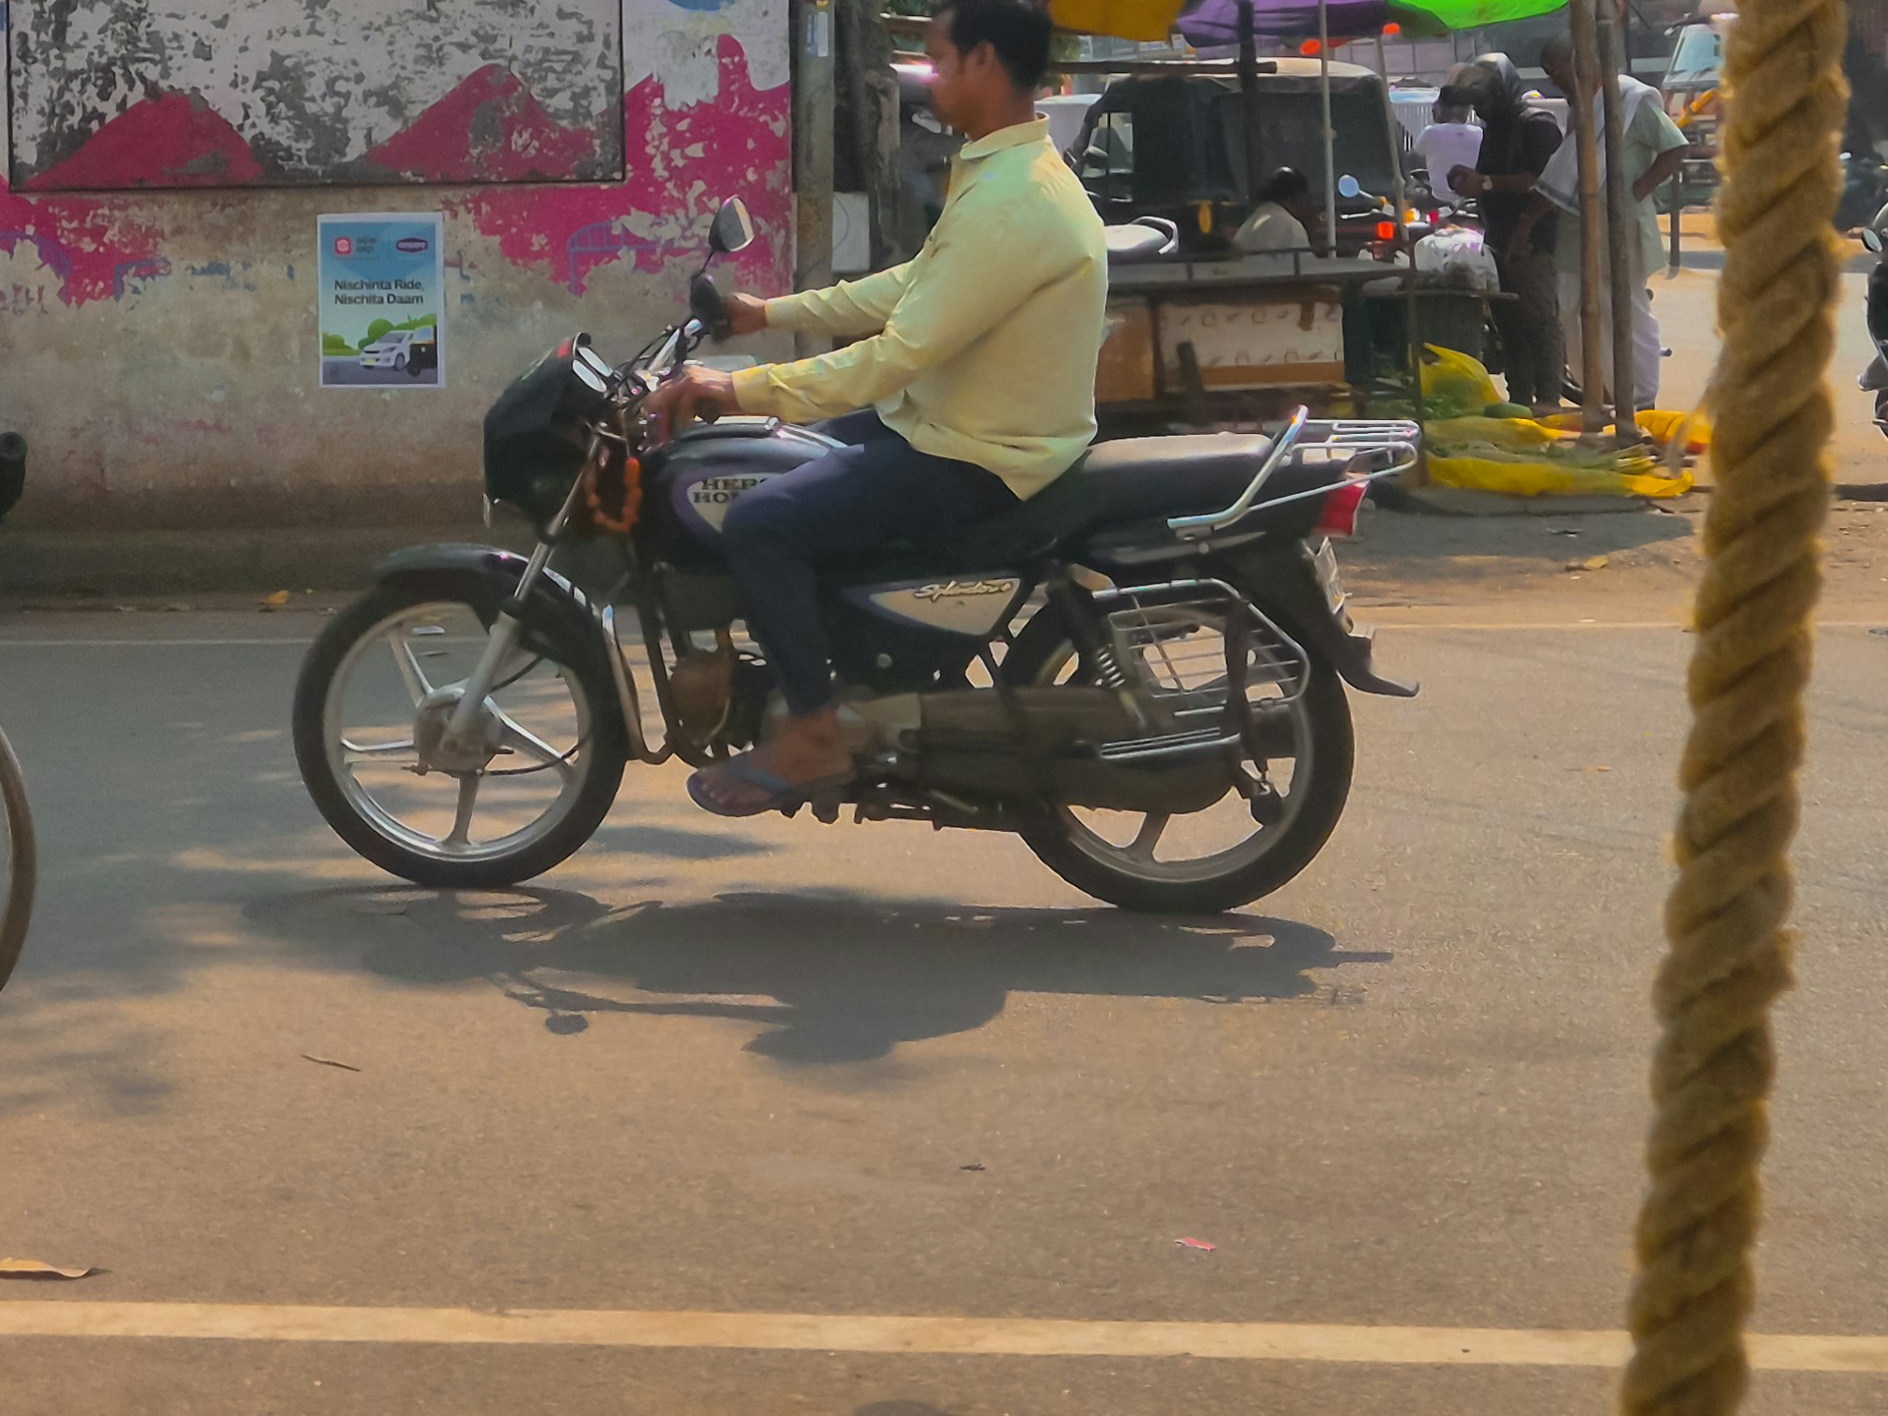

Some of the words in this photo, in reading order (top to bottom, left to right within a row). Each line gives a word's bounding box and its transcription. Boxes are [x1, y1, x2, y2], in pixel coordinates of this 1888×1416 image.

[334, 279, 392, 291] Nischinta
[394, 279, 425, 292] Ride,
[334, 294, 385, 305] Nischita
[387, 293, 424, 305] Daam
[702, 477, 767, 490] HER
